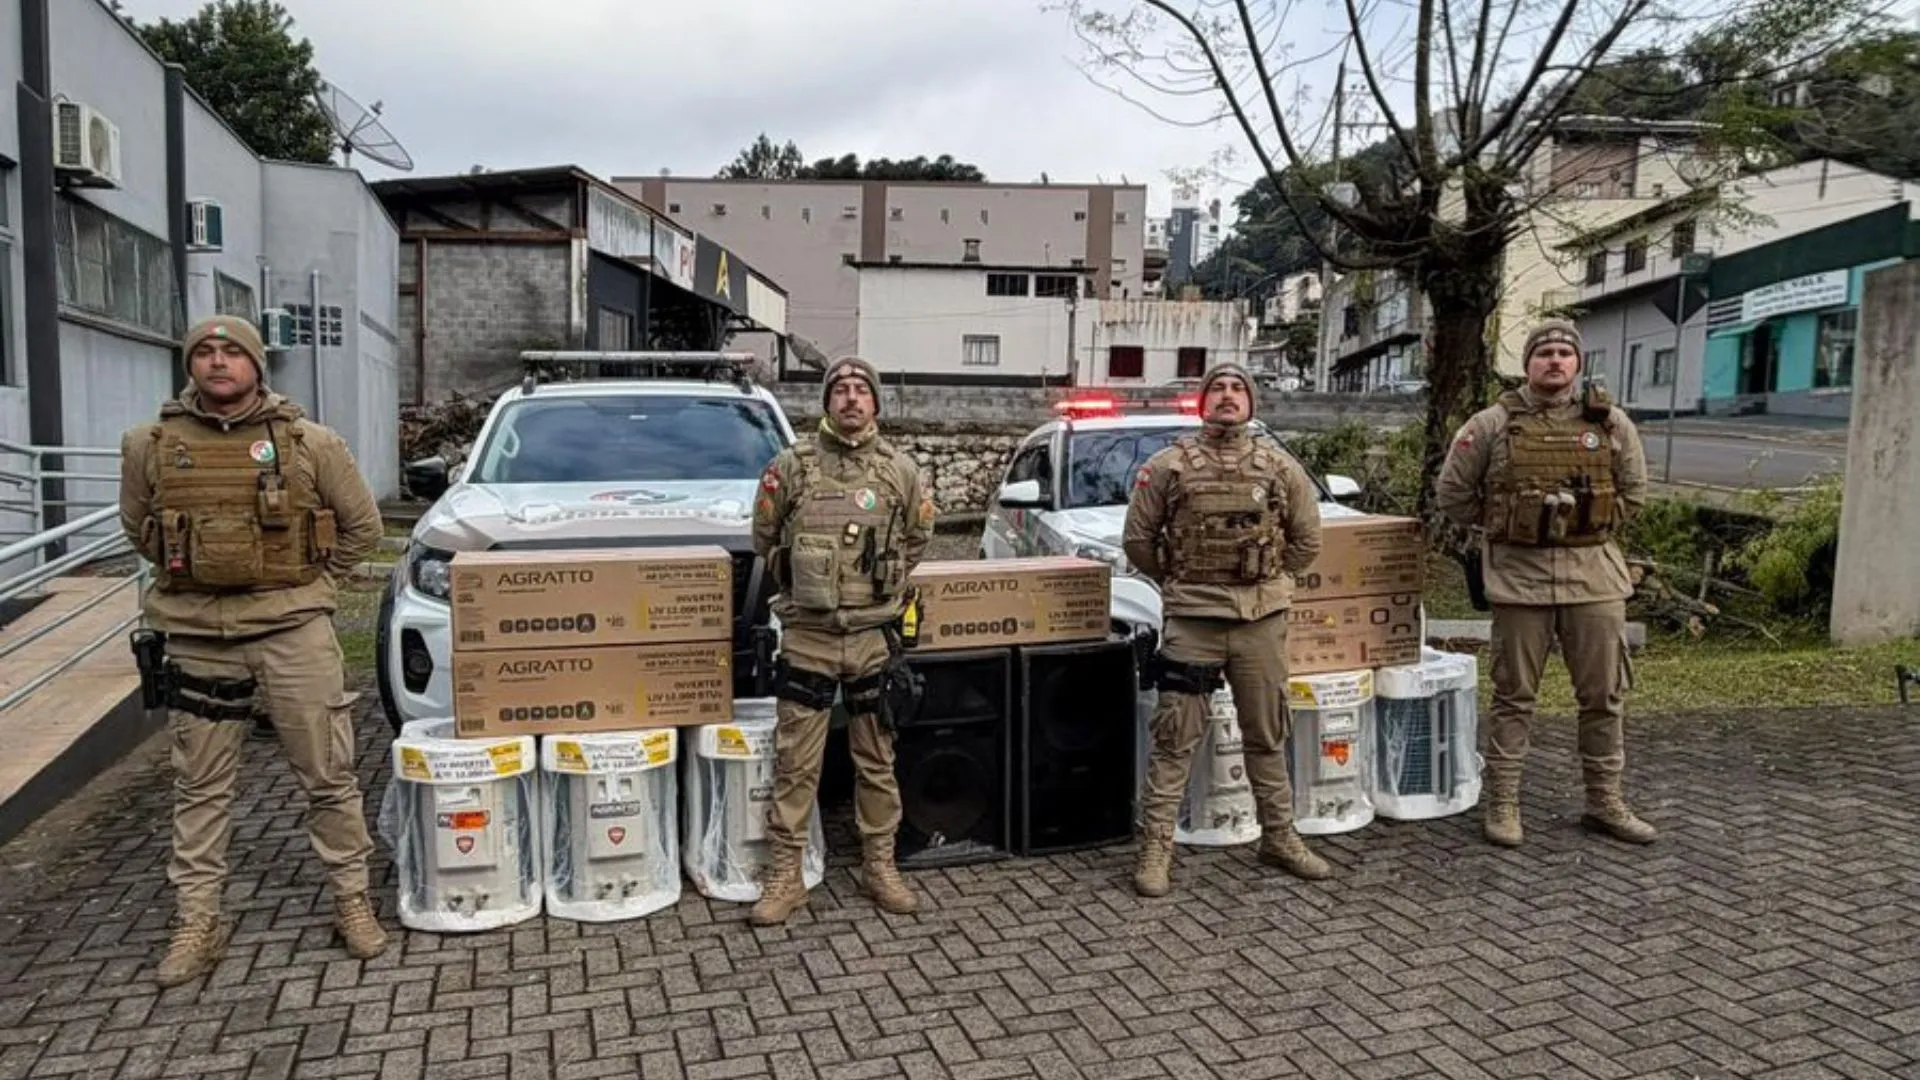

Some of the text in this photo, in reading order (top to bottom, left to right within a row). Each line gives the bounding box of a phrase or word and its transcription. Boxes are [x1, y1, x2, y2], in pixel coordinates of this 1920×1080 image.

[497, 570, 594, 586] AGRATTO
[941, 579, 1019, 595] AGRATTO
[498, 658, 594, 675] AGRATTO
